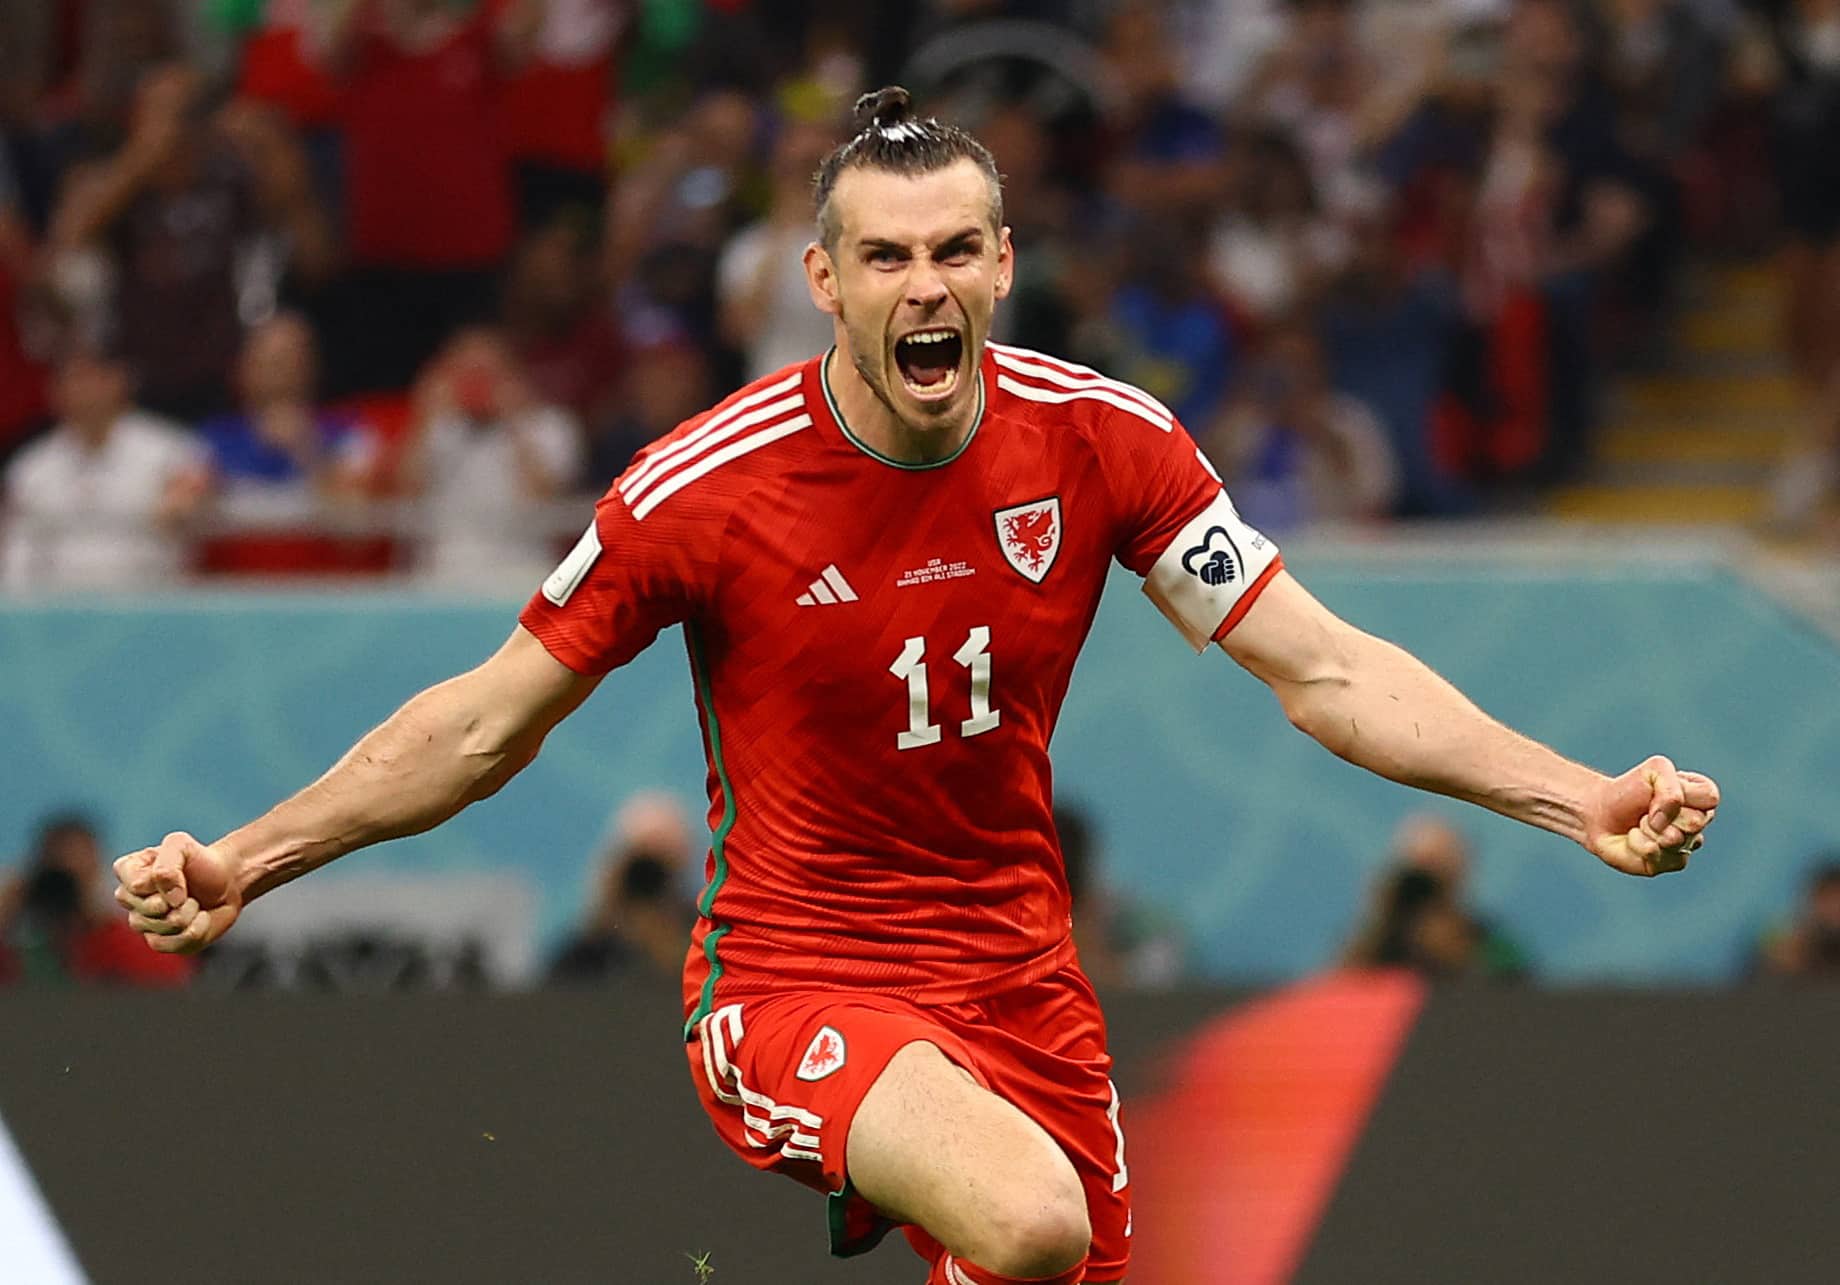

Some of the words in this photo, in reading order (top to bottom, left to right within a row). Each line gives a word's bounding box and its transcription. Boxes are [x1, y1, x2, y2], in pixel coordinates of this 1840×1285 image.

[904, 570, 912, 579] 21
[913, 565, 948, 576] NOVEMBER
[948, 561, 967, 571] 2022
[946, 568, 976, 579] STADIUM
[889, 625, 1000, 750] 11
